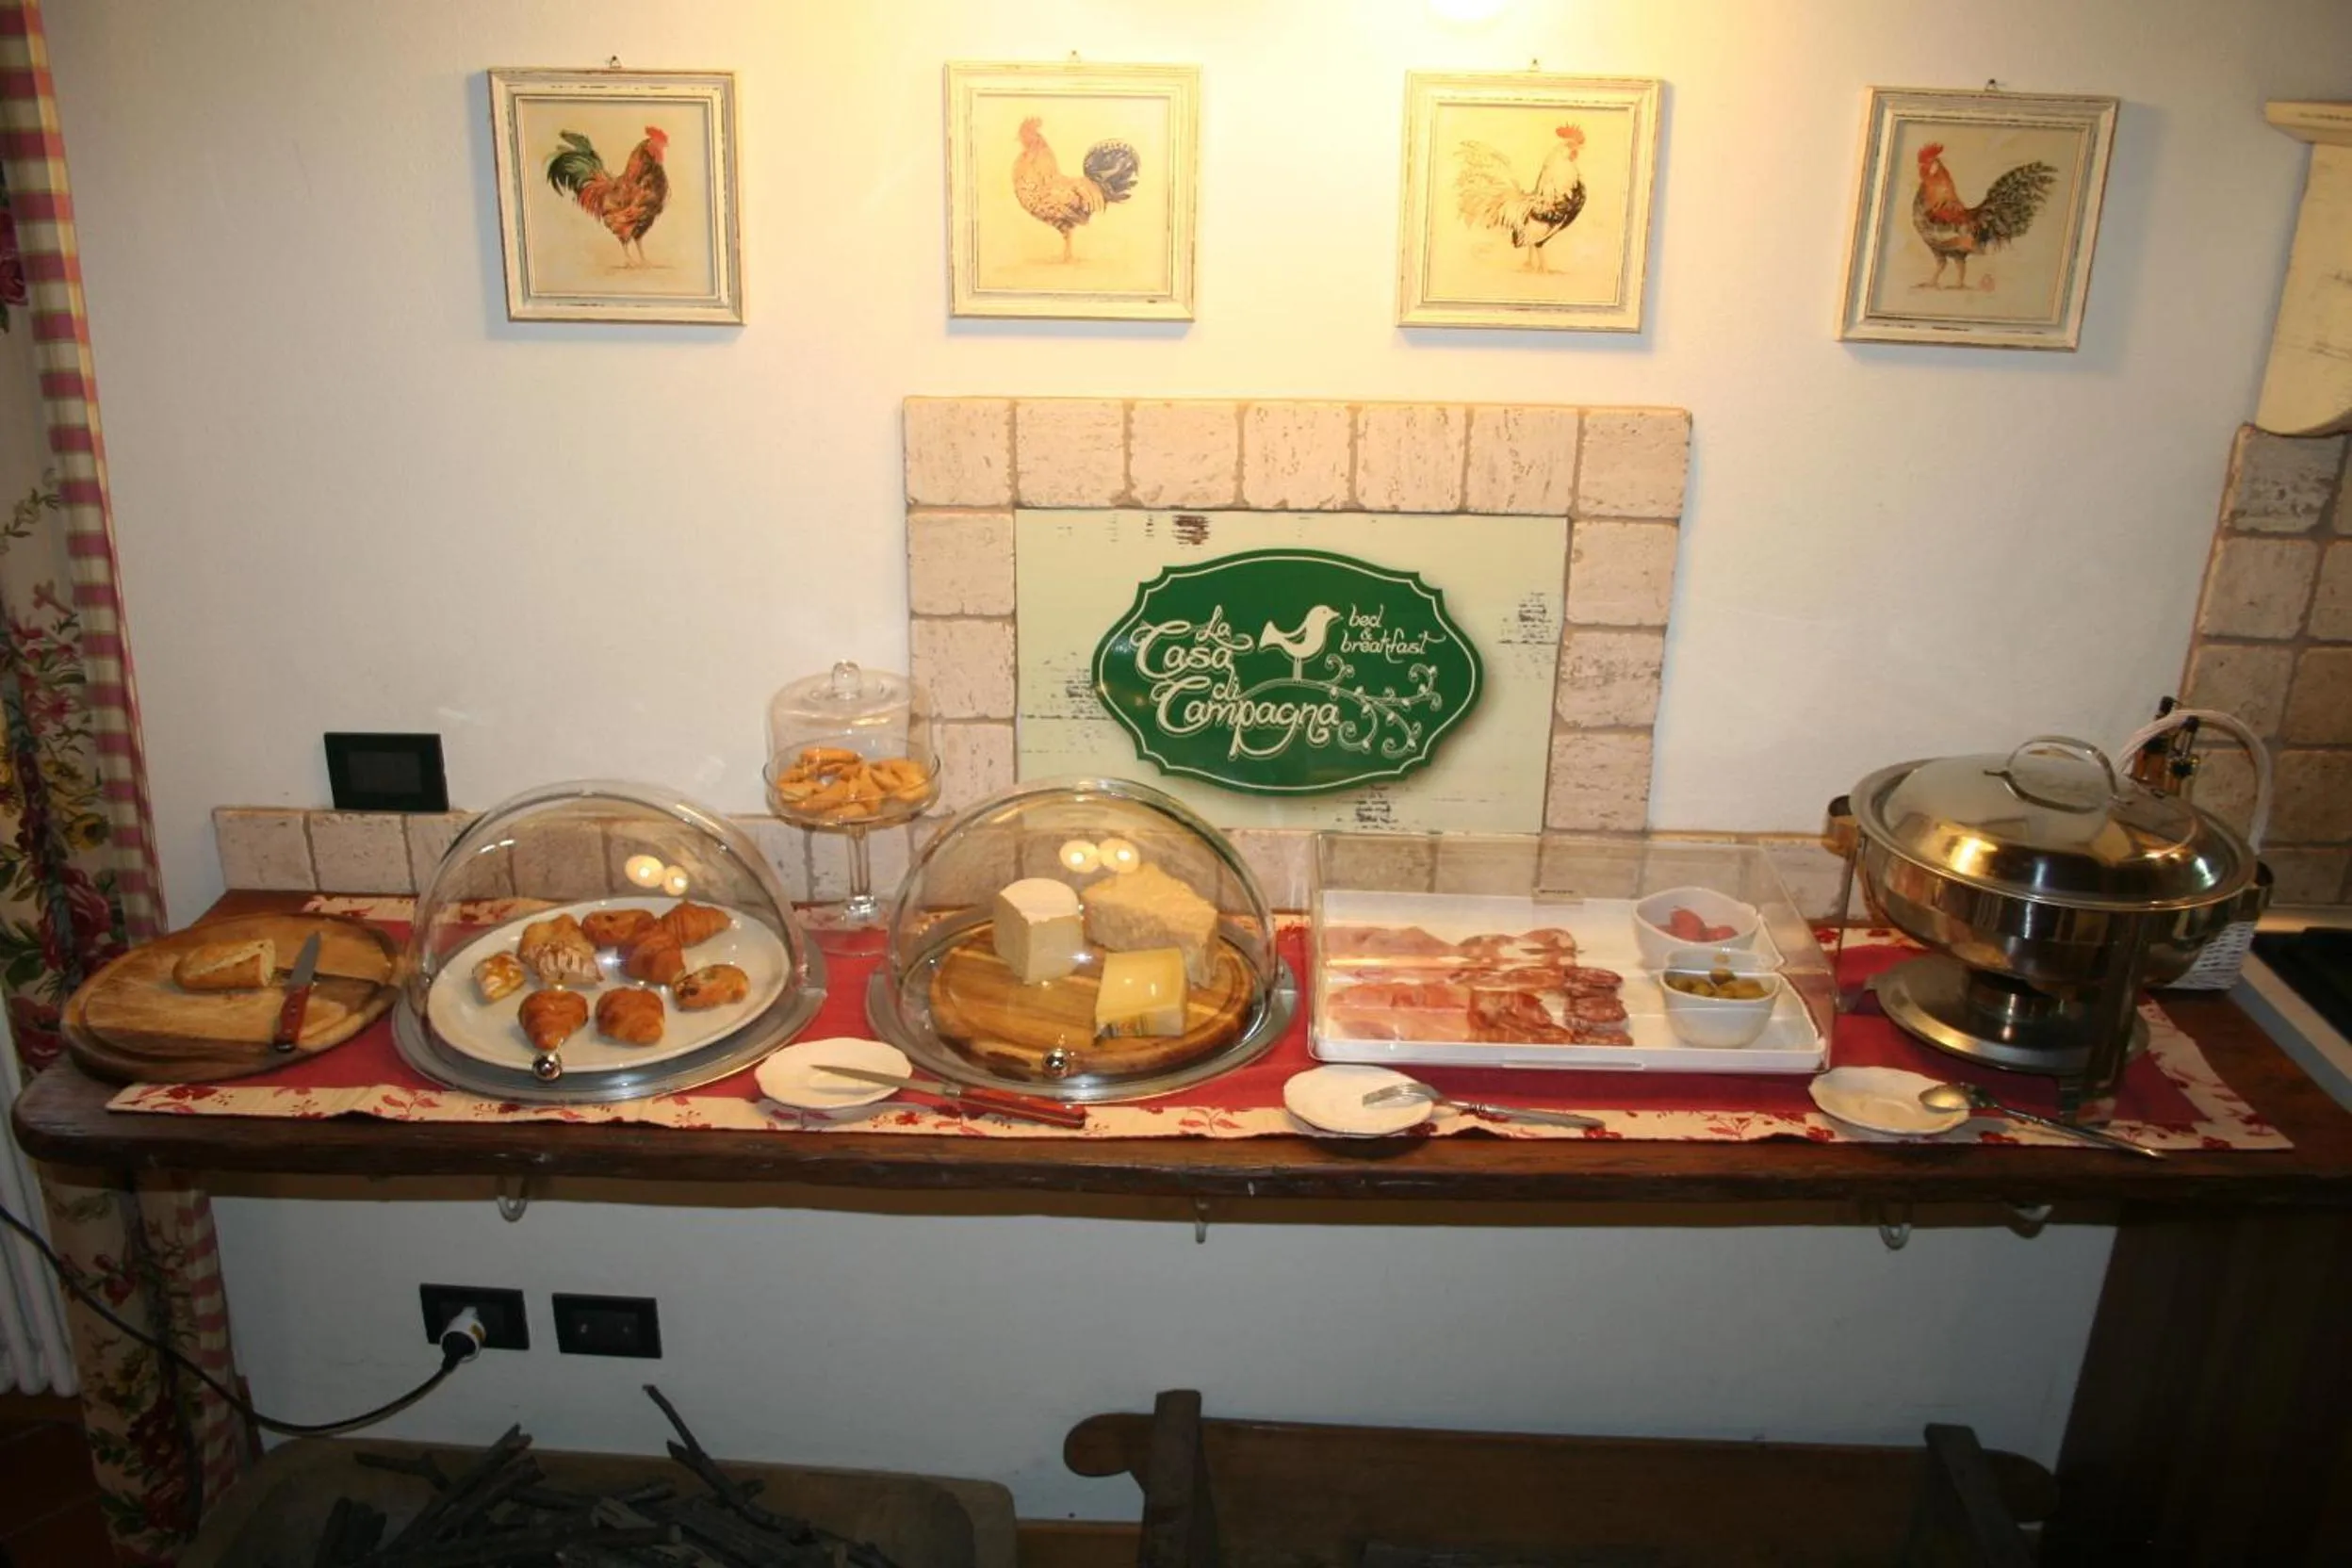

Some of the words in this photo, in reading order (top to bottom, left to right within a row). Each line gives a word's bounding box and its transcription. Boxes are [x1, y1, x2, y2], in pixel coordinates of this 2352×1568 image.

[1195, 604, 1253, 651] La
[1349, 603, 1383, 628] bed
[1131, 620, 1234, 680] Casa
[1341, 629, 1446, 663] breakfast
[1360, 627, 1373, 641] &
[1213, 671, 1241, 701] di
[1151, 676, 1340, 760] Campagna
